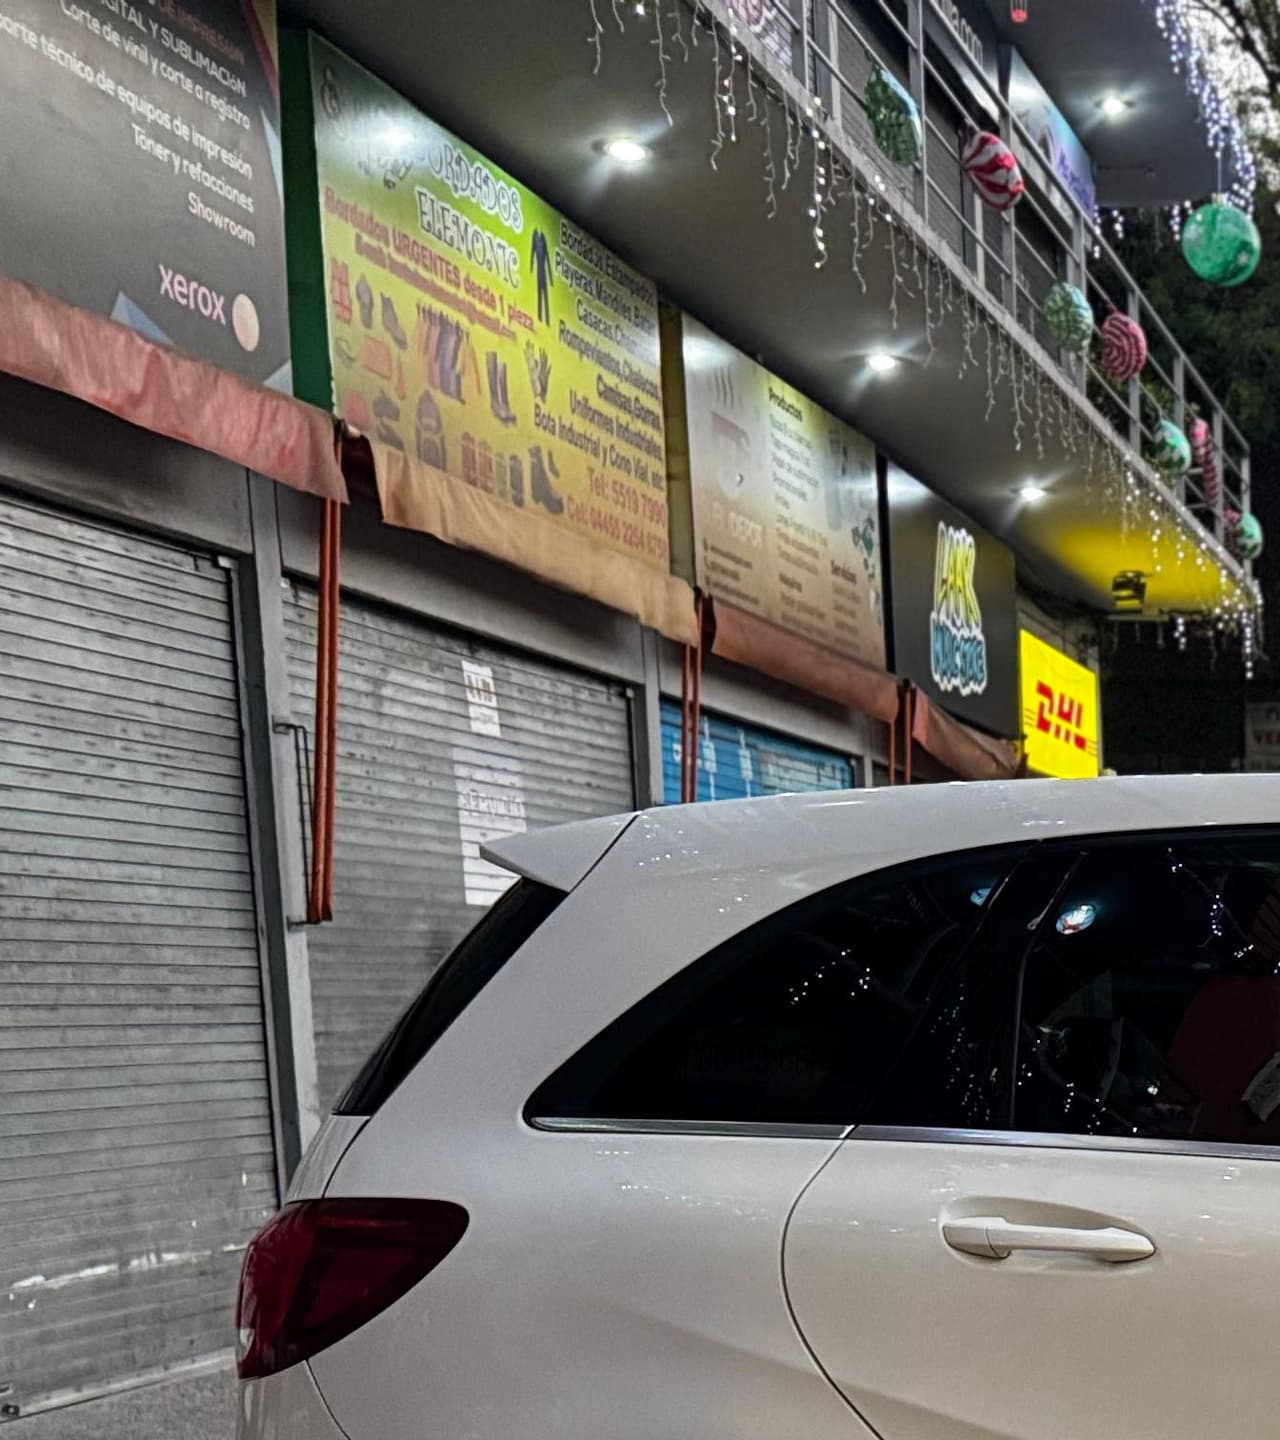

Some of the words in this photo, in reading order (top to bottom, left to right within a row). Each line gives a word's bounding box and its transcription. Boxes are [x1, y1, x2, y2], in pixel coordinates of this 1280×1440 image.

[101, 0, 147, 33] GITAL
[149, 18, 159, 39] Y
[40, 34, 94, 83] técnico
[95, 70, 117, 96] de
[116, 85, 172, 130] equipos
[172, 115, 190, 142] de
[191, 124, 253, 180] impresión
[102, 23, 121, 47] de
[122, 35, 149, 65] vinil
[149, 55, 160, 76] y
[159, 61, 194, 94] corte
[194, 84, 203, 99] a
[204, 88, 251, 130] registro
[131, 122, 172, 162] Tóner
[171, 153, 182, 175] y
[182, 160, 254, 213] refacciones
[420, 140, 522, 231] ORDADOS
[188, 191, 255, 247] Showroom
[323, 186, 390, 247] Bordados
[391, 227, 461, 293] URGENTES
[463, 273, 497, 312] desde
[499, 294, 506, 318] 1
[159, 263, 226, 326] xerox
[534, 402, 556, 436] Bota
[558, 415, 601, 459] Industrial
[601, 444, 608, 468] y
[1036, 680, 1087, 750] DHL
